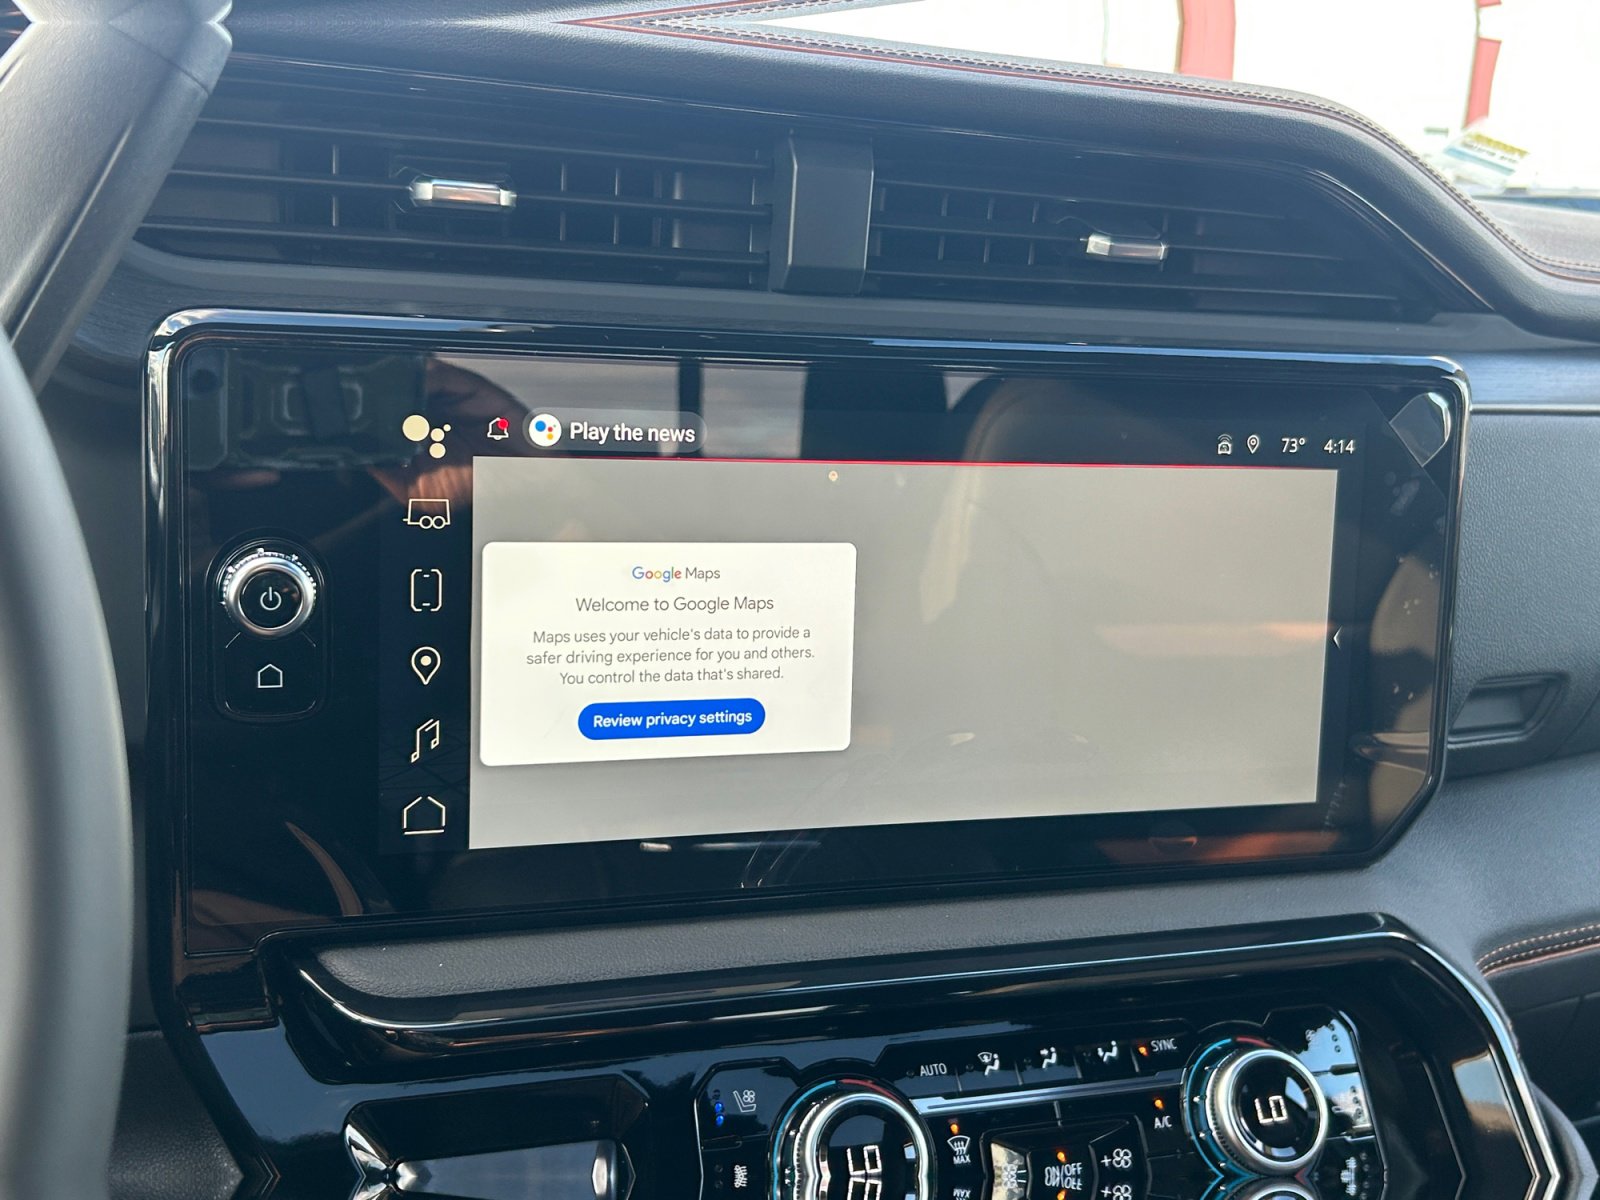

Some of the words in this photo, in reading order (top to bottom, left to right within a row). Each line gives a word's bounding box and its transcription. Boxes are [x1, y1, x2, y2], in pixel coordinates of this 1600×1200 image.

[570, 422, 610, 444] Play
[613, 422, 643, 441] the
[648, 427, 695, 442] news
[1282, 437, 1306, 453] 73°
[1323, 439, 1355, 454] 4:14
[632, 566, 681, 583] Google
[685, 567, 720, 582] Maps
[576, 598, 649, 611] Welcome
[654, 598, 669, 611] to
[674, 597, 729, 614] Google
[734, 596, 774, 613] Maps
[534, 631, 570, 646] Maps
[575, 633, 606, 642] uses
[610, 632, 640, 645] your
[644, 628, 700, 641] vehicle's
[704, 627, 732, 640] data
[737, 628, 749, 639] to
[753, 626, 799, 642] provide
[803, 629, 810, 638] a
[527, 651, 562, 664] safer
[566, 650, 612, 666] driving
[617, 649, 691, 665] experience
[696, 648, 713, 660] for
[717, 651, 740, 663] you
[744, 646, 767, 659] and
[771, 646, 814, 659] others.
[560, 673, 584, 684] You
[588, 670, 634, 684] control
[639, 669, 660, 682] the
[665, 669, 693, 681] data
[697, 668, 733, 680] that's
[737, 666, 783, 679] shared.
[594, 714, 643, 727] Review
[646, 712, 696, 728] privacy
[699, 710, 752, 725] settings
[1151, 1038, 1177, 1052] SYNC
[920, 1063, 948, 1077] AUTO
[1155, 1115, 1172, 1129] A/C
[953, 1155, 971, 1164] MAX
